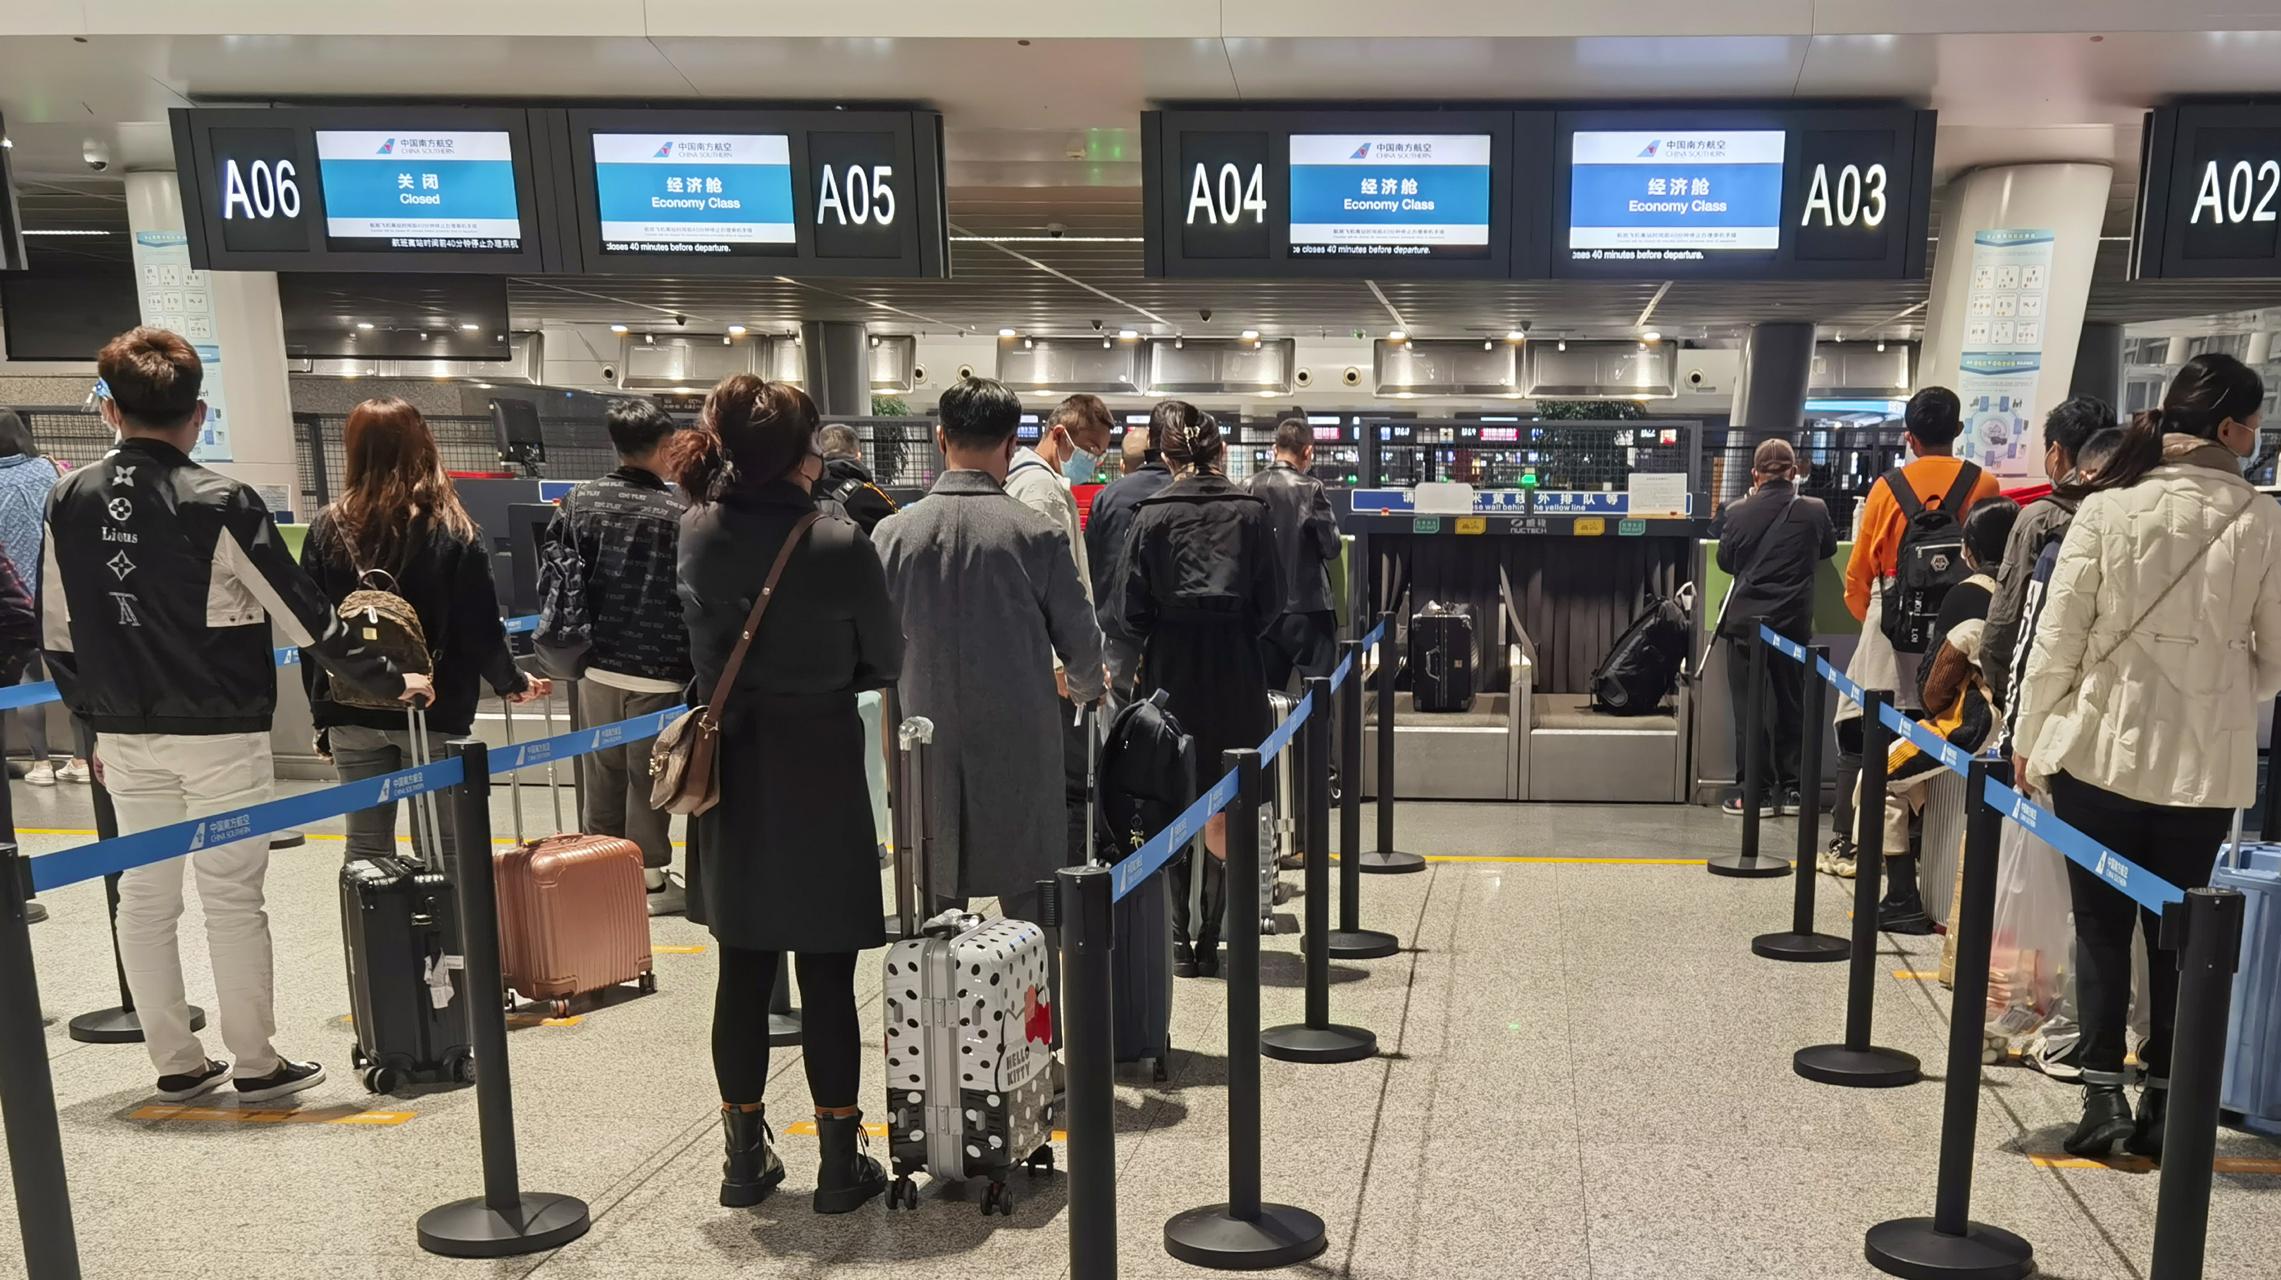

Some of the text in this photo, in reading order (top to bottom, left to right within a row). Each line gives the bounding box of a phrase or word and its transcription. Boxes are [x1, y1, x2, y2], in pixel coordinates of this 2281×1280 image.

[400, 139, 454, 148] 中国南方航空
[678, 142, 733, 152] 中国南方航空
[1376, 143, 1432, 153] 中国南方航空
[1666, 140, 1726, 150] 中国南方航空
[224, 159, 301, 220] A06
[666, 176, 723, 194] 经济舱
[1360, 177, 1418, 195] 经济舱
[1647, 177, 1710, 196] 经济舱
[2190, 160, 2281, 224] A02
[400, 193, 440, 205] Closed
[817, 164, 896, 225] A05
[1186, 163, 1267, 224] A04
[1801, 163, 1887, 227] A03
[651, 197, 741, 211] Economy Class
[1344, 199, 1435, 212] Economy Class
[1629, 200, 1727, 214] Economy Class
[630, 243, 640, 251] 40
[641, 243, 669, 252] minutes
[670, 243, 693, 252] before
[695, 244, 731, 253] departure.
[1302, 246, 1326, 254] closes
[1327, 246, 1337, 254] 40
[1338, 246, 1367, 254] minutes
[1368, 246, 1392, 254] before
[1393, 246, 1430, 255] departure.
[1592, 250, 1602, 259] 40
[1604, 250, 1635, 259] minutes
[1636, 250, 1662, 259] before
[1663, 250, 1704, 261] departure.
[1485, 503, 1501, 511] wait
[1503, 503, 1525, 511] behin
[1534, 504, 1543, 512] he
[1544, 504, 1570, 512] yellow
[1006, 1045, 1030, 1070] HELLO
[1007, 1060, 1031, 1086] KITTY
